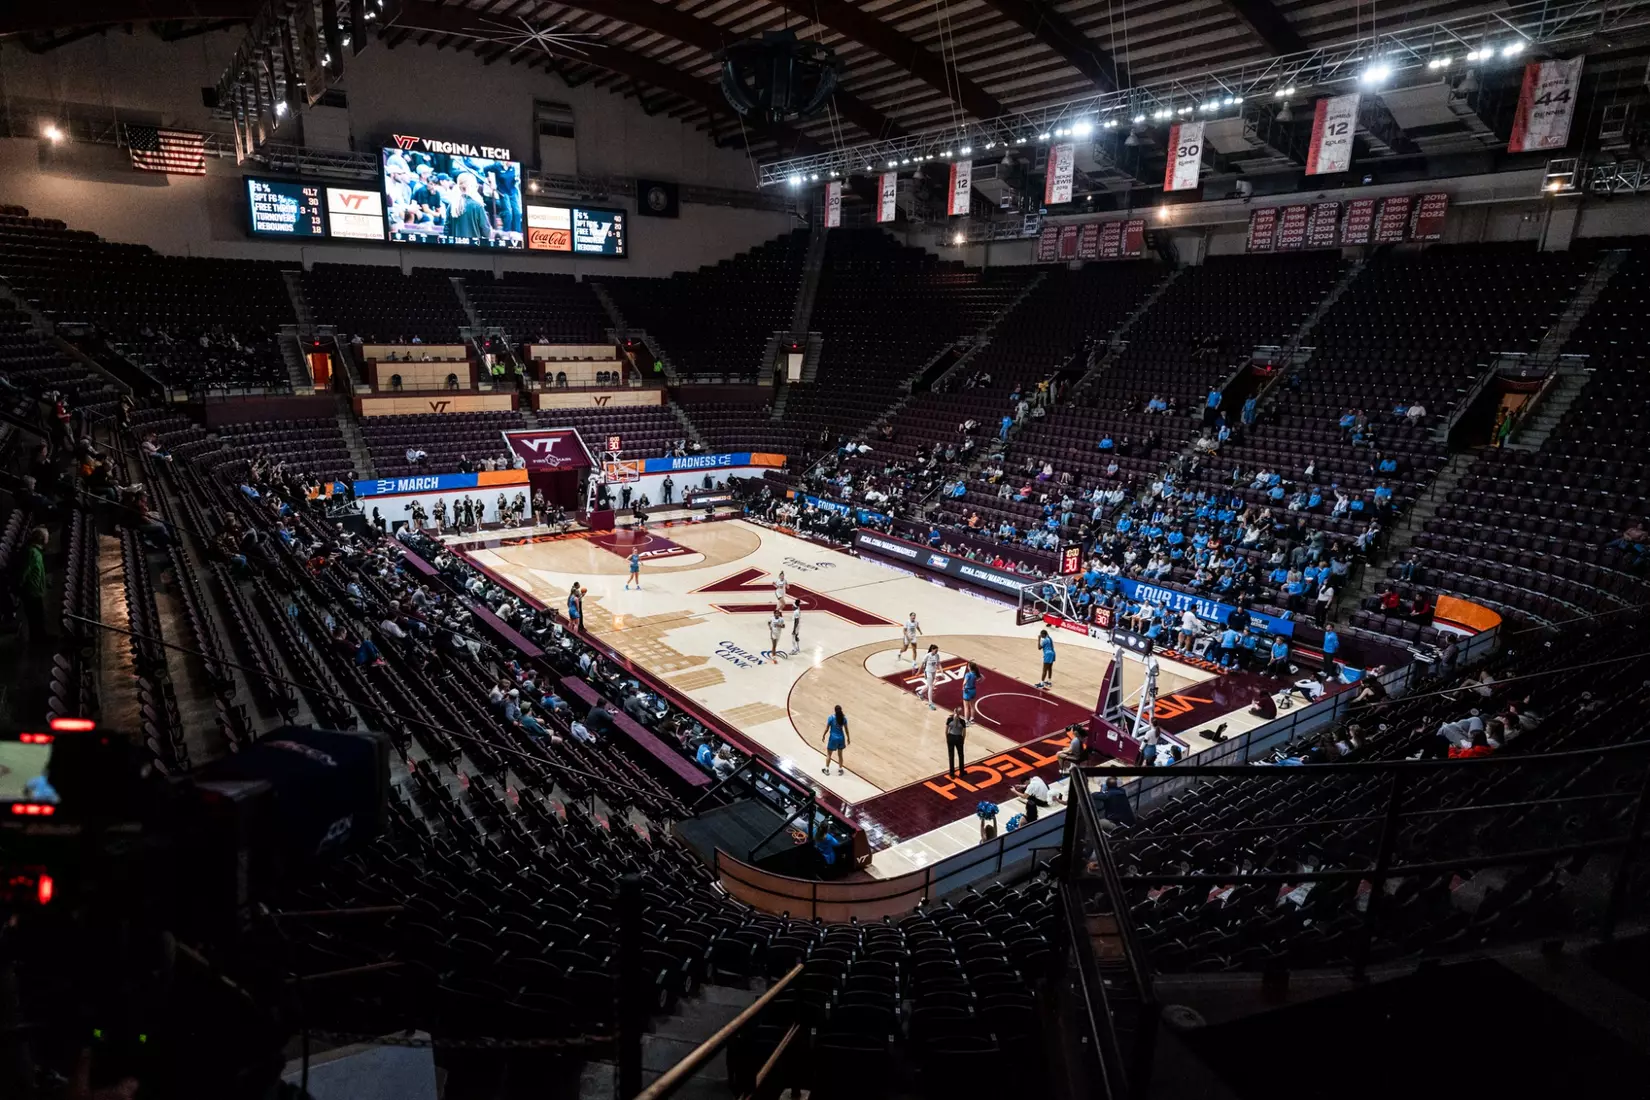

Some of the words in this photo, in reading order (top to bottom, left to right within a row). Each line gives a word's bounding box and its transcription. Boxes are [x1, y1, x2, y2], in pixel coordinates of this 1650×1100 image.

[1534, 89, 1571, 106] 44
[1534, 109, 1565, 119] DENNIS
[1328, 122, 1348, 136] 12
[393, 134, 419, 149] VT
[422, 139, 480, 157] VIRGINIA
[481, 146, 511, 160] TECH
[1178, 145, 1199, 158] 30
[958, 180, 968, 188] 12
[302, 188, 318, 196] 41.7
[884, 190, 894, 198] 44
[256, 202, 272, 212] FREE
[339, 194, 369, 210] VT
[256, 212, 296, 223] TURNOVERS
[257, 222, 294, 232] REBOUNDS
[429, 400, 450, 413] VT
[594, 396, 612, 407] VT
[521, 438, 562, 452] VT
[610, 442, 619, 450] 30
[672, 455, 716, 468] MADNESS
[398, 477, 439, 491] MARCH
[818, 500, 835, 510] FOUR
[637, 547, 684, 558] ACC
[860, 535, 918, 558] NCAA.COM/MARCHMADNESS
[1066, 548, 1079, 557] 10:00
[1065, 558, 1077, 572] 30
[1135, 584, 1172, 607] FOUR
[1173, 595, 1192, 610] IT
[1196, 600, 1219, 622] ALL
[1096, 616, 1107, 624] 30
[715, 650, 752, 669] CLINIC
[719, 641, 763, 665] CARILION
[906, 665, 967, 692] ACC
[922, 746, 1062, 801] TECH
[856, 854, 869, 864] VT
